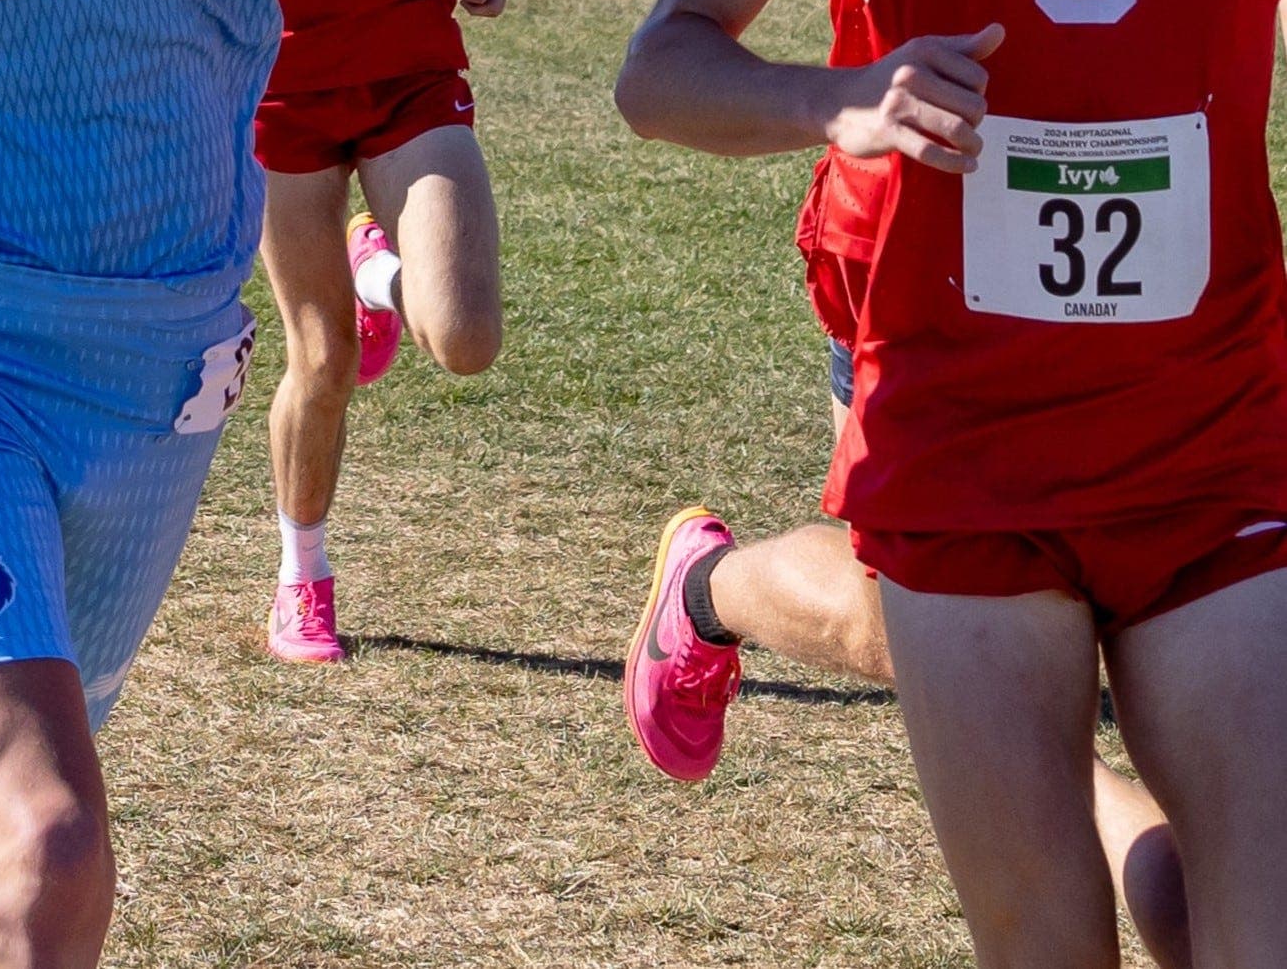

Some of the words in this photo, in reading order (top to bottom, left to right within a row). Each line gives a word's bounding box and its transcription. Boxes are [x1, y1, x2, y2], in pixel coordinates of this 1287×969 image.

[1043, 128, 1067, 137] 2024
[1069, 128, 1132, 138] HEPTAGONAL
[1008, 135, 1041, 146] CROSS
[1042, 138, 1088, 148] COUNTRY
[1089, 135, 1169, 148] CHAMPIONSHIPS
[1045, 149, 1077, 157] CAMPUS
[1105, 148, 1140, 156] COUNTRY
[1058, 164, 1098, 191] Ivy
[1038, 198, 1143, 297] 32
[1063, 302, 1118, 317] CANADAY
